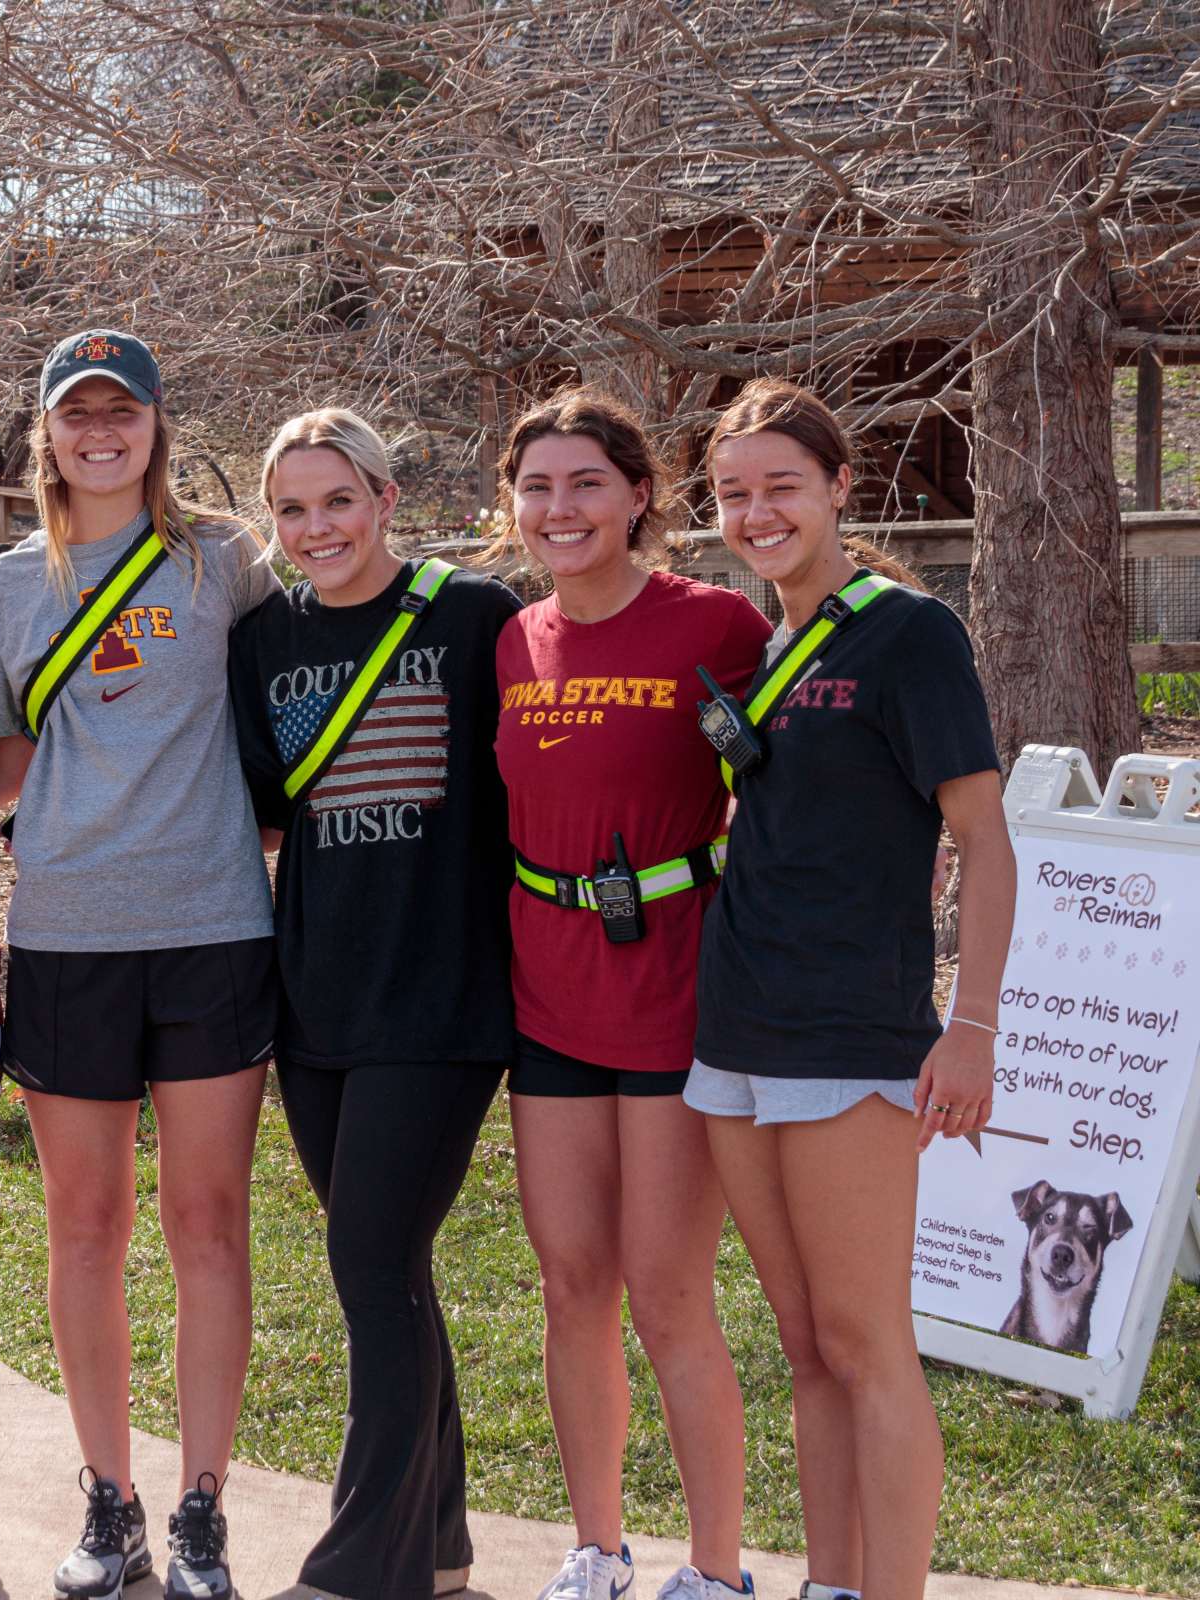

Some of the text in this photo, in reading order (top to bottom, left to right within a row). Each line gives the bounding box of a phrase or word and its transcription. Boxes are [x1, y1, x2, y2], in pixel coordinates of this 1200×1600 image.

[75, 344, 121, 359] STATE
[560, 677, 678, 709] STATE
[520, 710, 604, 725] SOCCER
[1037, 861, 1116, 895] Rovers
[1054, 894, 1161, 930] at Reiman
[1044, 995, 1075, 1021] op
[1081, 995, 1120, 1023] this
[1126, 1006, 1179, 1038] way!
[1005, 1032, 1019, 1048] a
[1022, 1031, 1084, 1060] photo
[1088, 1043, 1117, 1065] of
[1118, 1050, 1169, 1075] your
[993, 1066, 1157, 1119] og with our dog,
[1069, 1119, 1144, 1165] Shep.
[916, 1232, 992, 1262] beyond Shep is
[920, 1217, 1006, 1247] Children's Garden
[912, 1251, 1003, 1283] closed for Rovers
